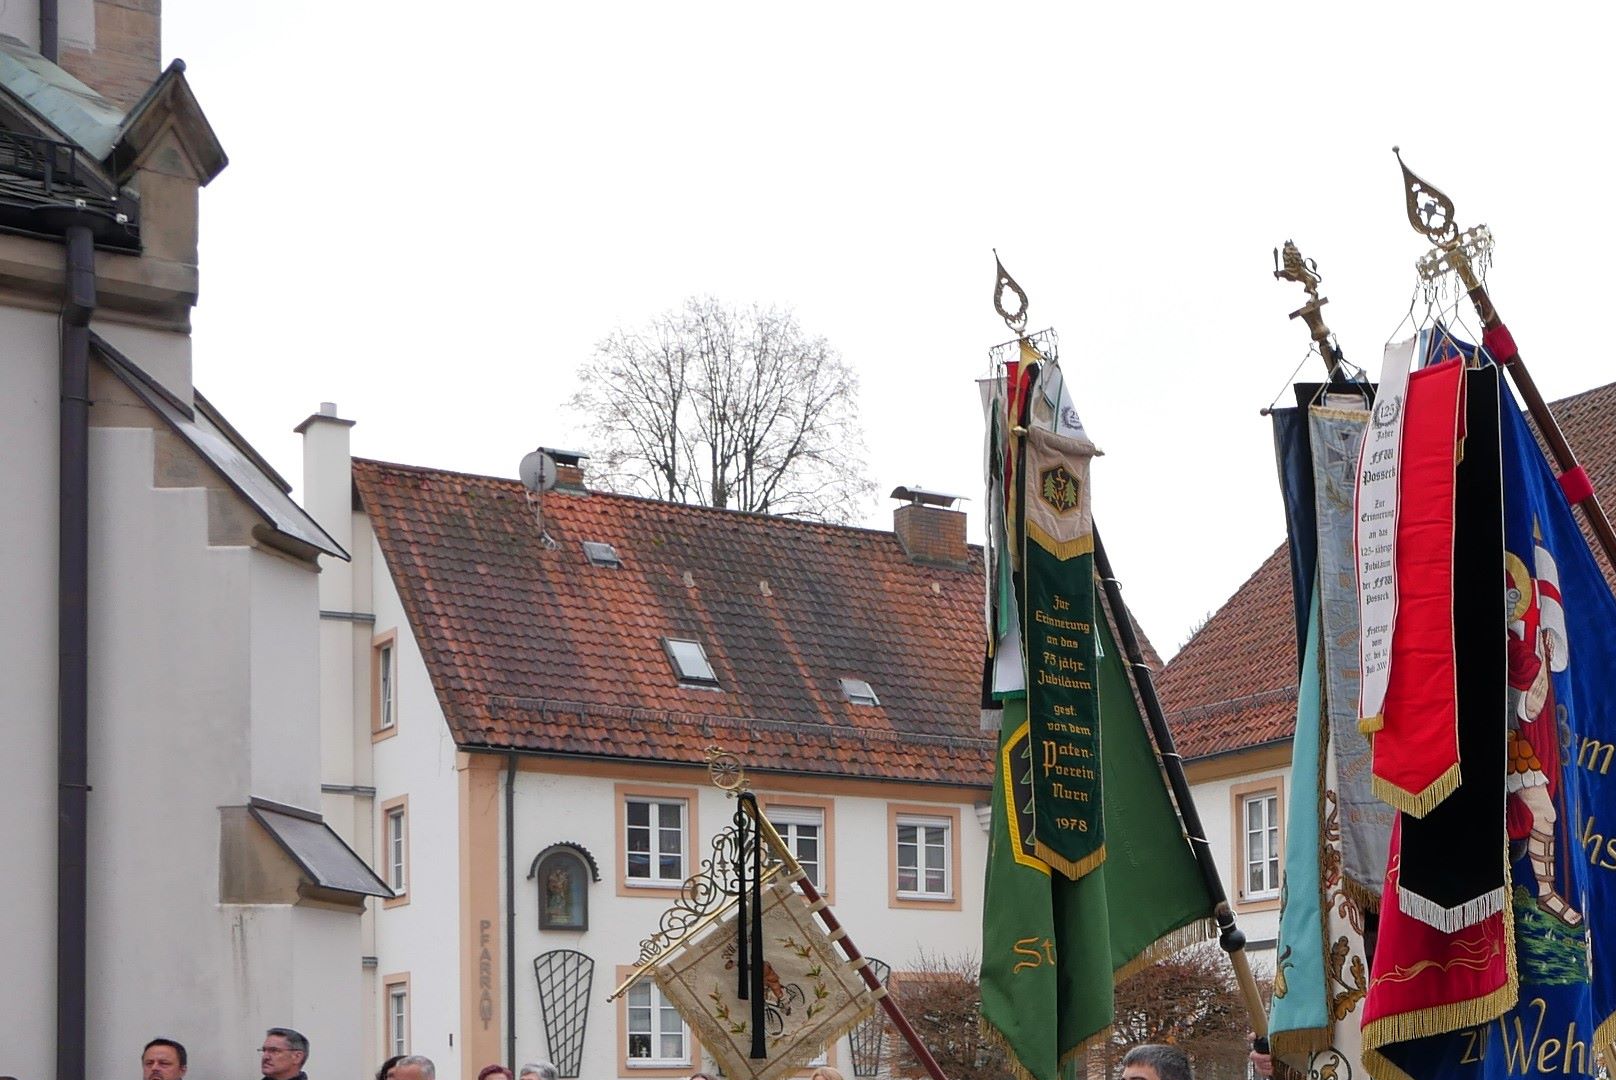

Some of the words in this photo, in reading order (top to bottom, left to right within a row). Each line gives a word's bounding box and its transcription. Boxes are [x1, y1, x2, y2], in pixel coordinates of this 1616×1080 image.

[1379, 403, 1396, 418] 125
[1362, 467, 1396, 486] Posseck
[1035, 610, 1090, 635] Erinnerung
[1046, 635, 1059, 646] an
[1060, 636, 1079, 649] das
[1037, 669, 1092, 690] Jubiläum
[1055, 817, 1088, 834] 1978
[1013, 937, 1056, 974] St
